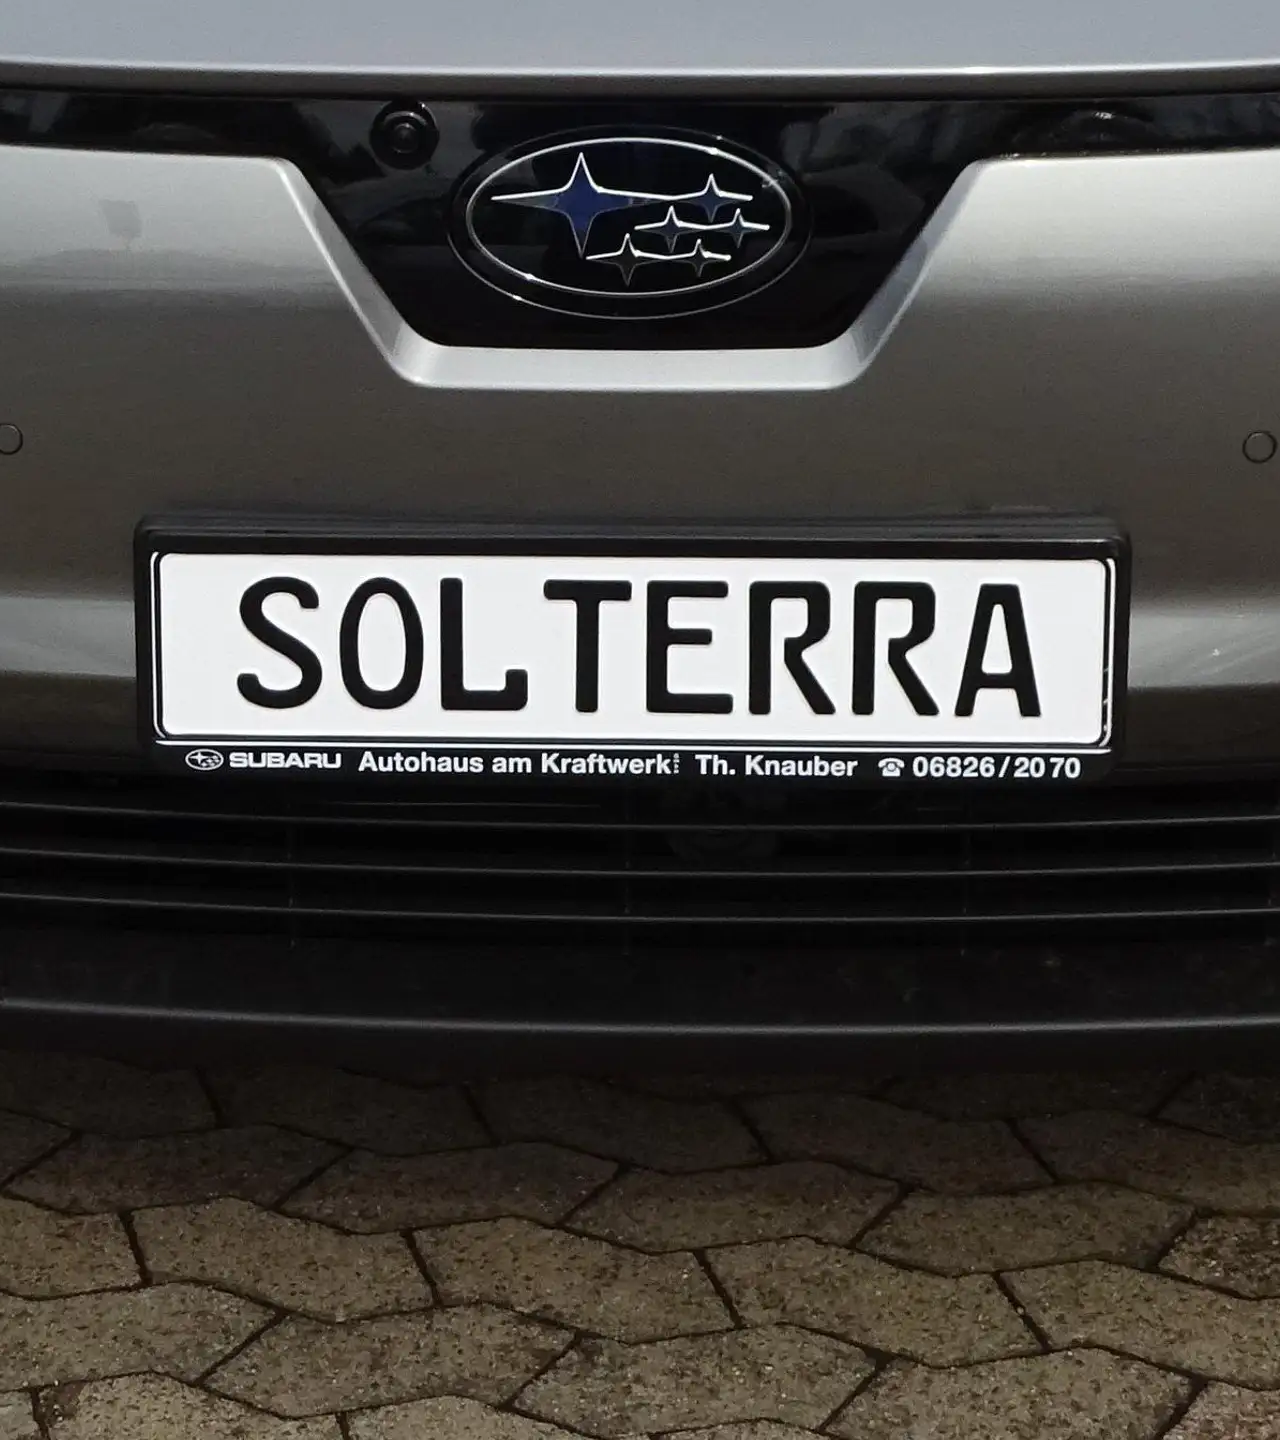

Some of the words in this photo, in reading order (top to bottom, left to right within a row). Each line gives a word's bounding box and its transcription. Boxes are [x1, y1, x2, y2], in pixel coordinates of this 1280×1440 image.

[236, 575, 1042, 719] SOLTERRA
[229, 752, 342, 769] SUBARU
[358, 750, 484, 773] Autohaus
[491, 756, 532, 774] am
[541, 752, 672, 775] Kraftwerk
[694, 753, 736, 776] Th.
[745, 754, 859, 777] Knauber
